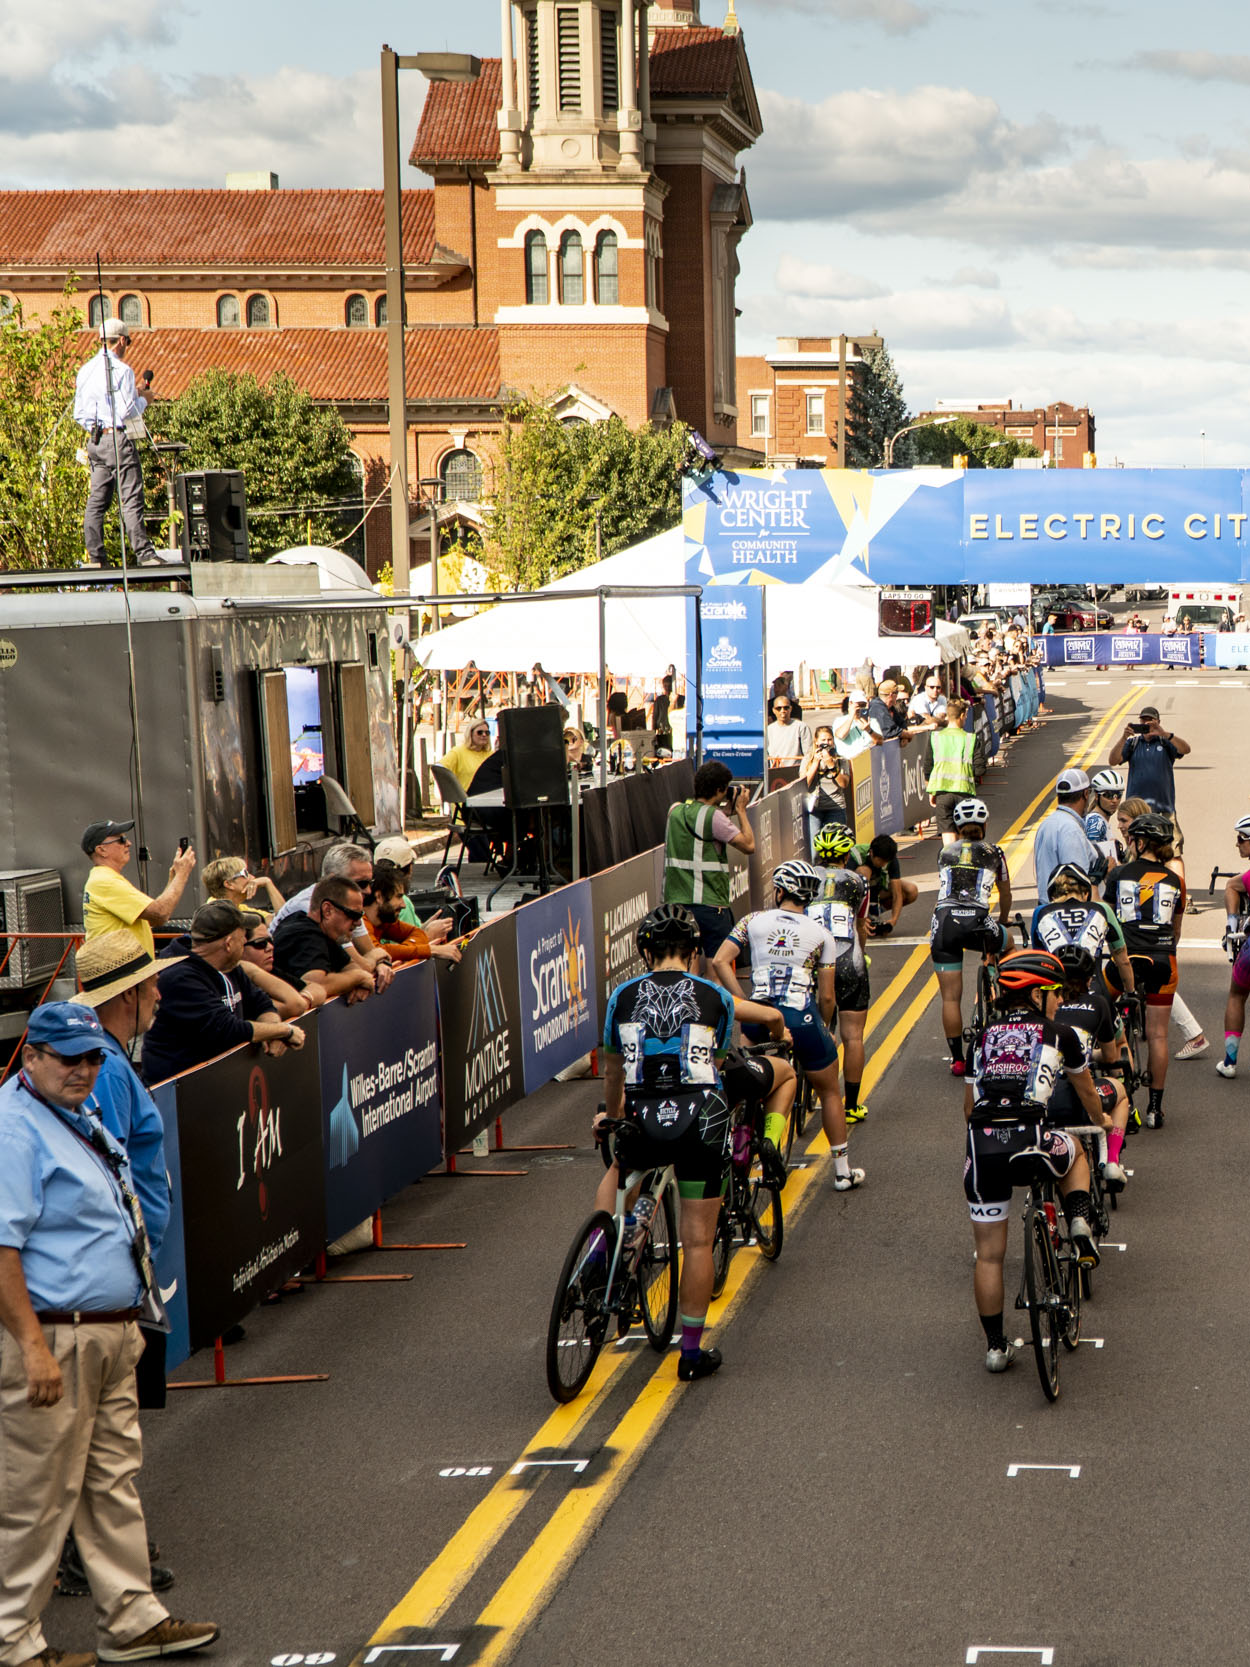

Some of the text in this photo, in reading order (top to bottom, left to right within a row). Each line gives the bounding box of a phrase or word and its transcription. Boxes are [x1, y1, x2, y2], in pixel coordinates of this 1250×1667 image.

[721, 490, 811, 511] WRIGHT
[720, 508, 811, 529] CENTER
[969, 513, 1167, 540] ELECTRIC
[731, 540, 797, 550] COMMUNITY
[732, 550, 798, 564] HEALTH
[609, 890, 649, 937] LACKAWANNA
[1044, 927, 1061, 946] 12
[1086, 924, 1102, 943] 12
[610, 931, 633, 970] COUNTY
[530, 943, 587, 1021] Scranton
[533, 1009, 569, 1054] TOMORROW
[988, 1023, 1037, 1034] MELLOW
[350, 1040, 437, 1109] Wilkes-Barre/Scranton
[464, 1029, 511, 1102] MONTAGE
[1038, 1063, 1053, 1087] 22
[361, 1067, 437, 1139] International Airport
[464, 1074, 511, 1127] MOUNTAIN
[237, 1107, 283, 1192] I AM
